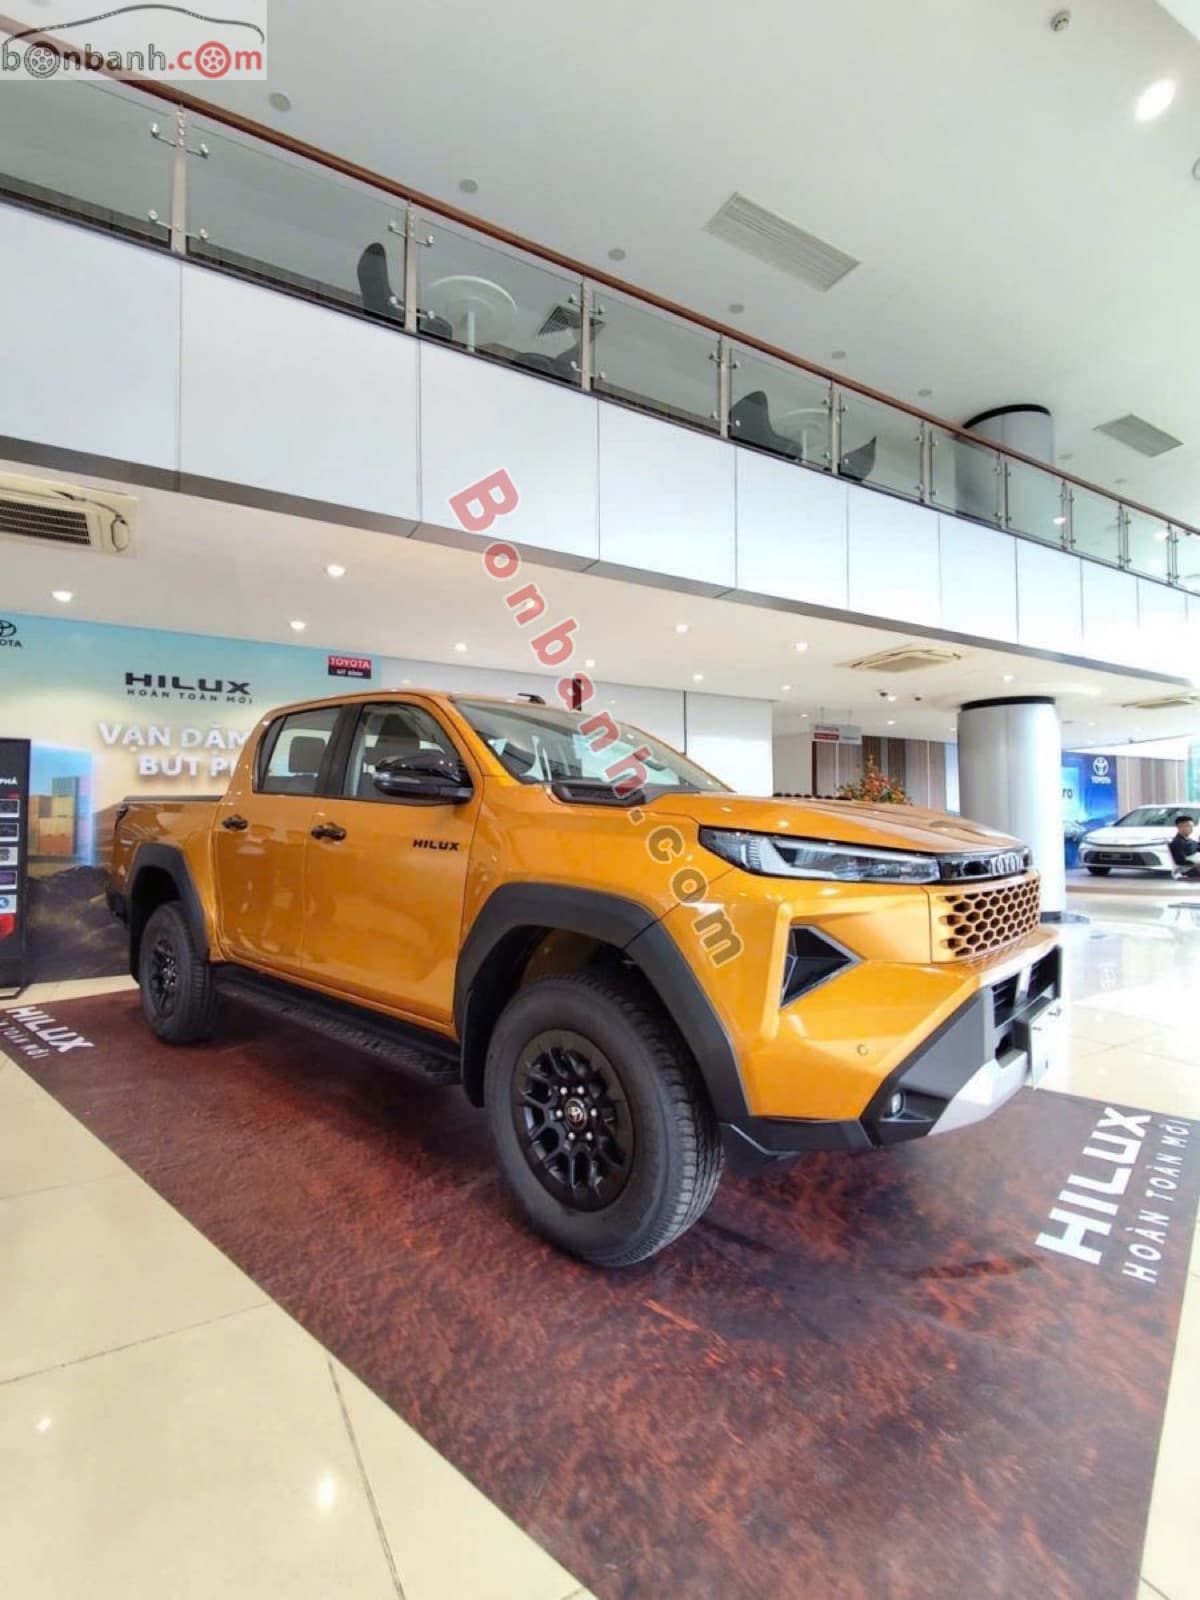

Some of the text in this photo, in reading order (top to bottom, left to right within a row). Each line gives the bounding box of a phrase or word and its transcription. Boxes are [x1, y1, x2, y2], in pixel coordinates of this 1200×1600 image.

[330, 657, 370, 669] TOYOTA
[125, 672, 251, 696] HILUX
[98, 721, 171, 752] VẠN
[412, 839, 460, 852] HILUX
[5, 1005, 95, 1053] HILUX
[1035, 1107, 1152, 1265] HILUX
[1121, 1118, 1192, 1284] HOÀN TOÀN MỚI
